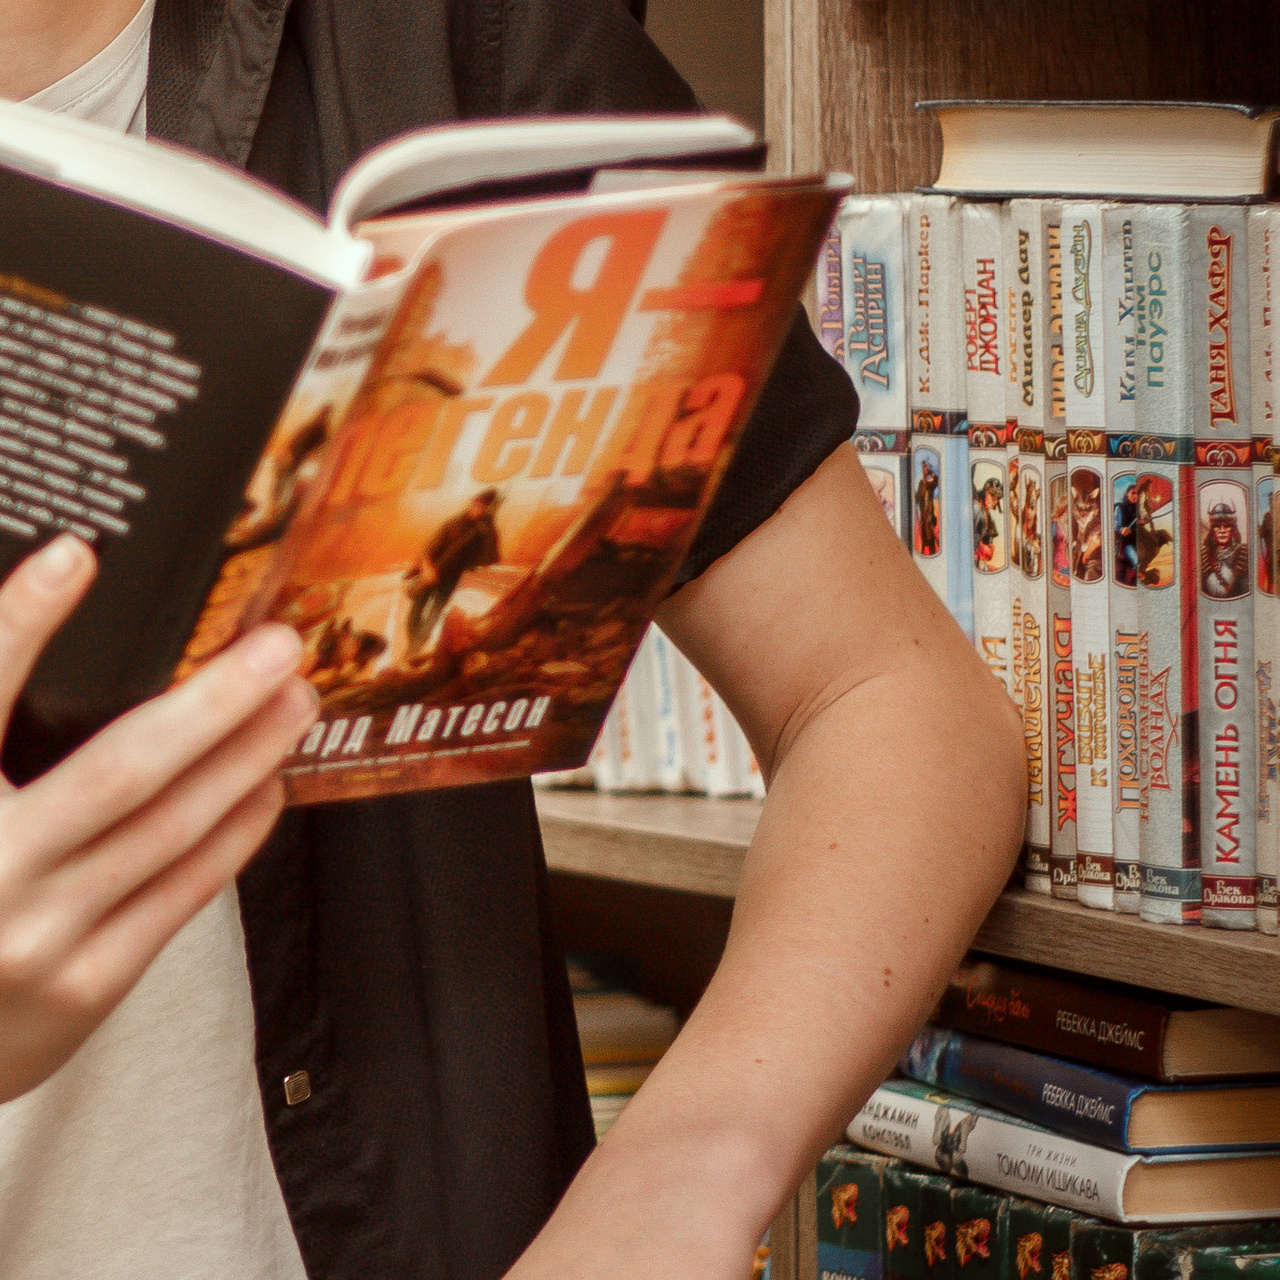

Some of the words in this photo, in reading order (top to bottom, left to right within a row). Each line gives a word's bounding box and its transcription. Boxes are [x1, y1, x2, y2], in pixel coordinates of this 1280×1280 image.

[477, 208, 670, 388] Я
[849, 253, 869, 356] РОБЕРТ
[918, 215, 931, 307] Паркер
[1207, 225, 1234, 334] ХАФФ
[860, 263, 889, 390] АСПРИН
[965, 285, 978, 371] РОБЕРТ
[976, 258, 1000, 376] ДЖОРДАН
[1022, 291, 1034, 407] Миллер
[1147, 251, 1168, 388] Пауэрс
[1209, 343, 1239, 430] ТАНЯ
[325, 372, 746, 502] легенда
[1089, 653, 1106, 760] КОРОЛЕВЕ
[1214, 619, 1239, 711] ОГНЯ
[289, 716, 372, 758] ард
[385, 696, 551, 744] Матесон
[1076, 669, 1093, 765] ВИЗИТ
[1115, 629, 1139, 813] ПОХОРОНЫ
[1150, 666, 1171, 791] ВОЛНАХ
[1090, 767, 1107, 787] К
[1215, 723, 1240, 864] КАМЕНЬ
[1203, 887, 1255, 904] Дракона
[1216, 880, 1240, 895] Век
[1056, 1009, 1096, 1035] РЕБЕККА
[1097, 1021, 1145, 1051] ДЖЕЙМС
[1042, 1083, 1076, 1110] РЕБЕККА
[1075, 1095, 1115, 1125] ДЖЕЙМС
[996, 1153, 1044, 1184] ТОМОМИ
[1045, 1163, 1100, 1200] ИШИКАВА
[1027, 1144, 1043, 1157] ТРИ
[1045, 1147, 1077, 1168] ЖИЗНИ
